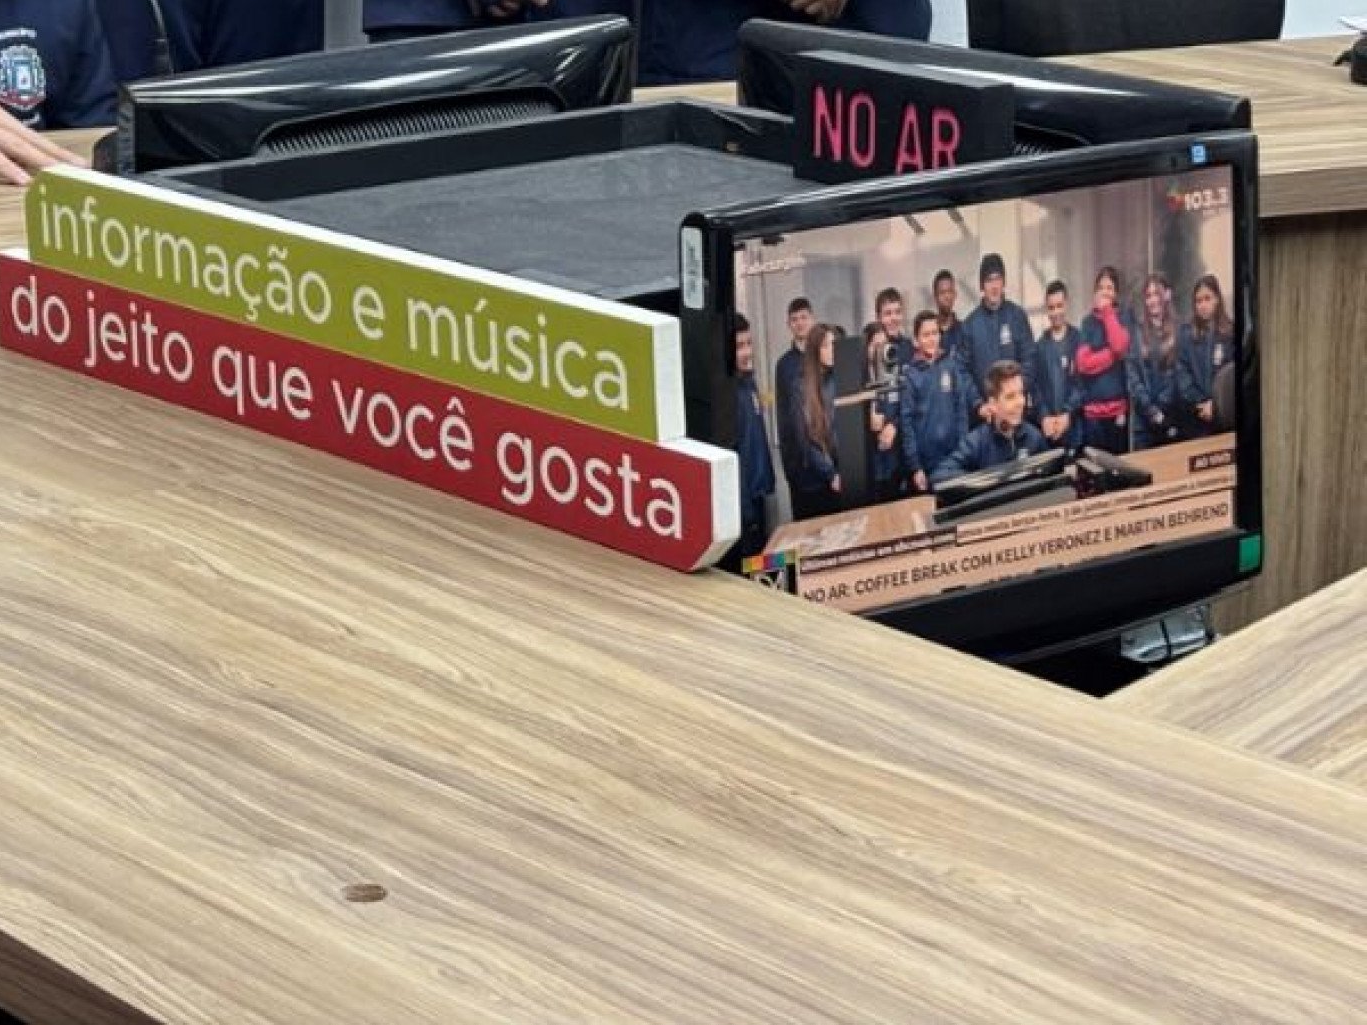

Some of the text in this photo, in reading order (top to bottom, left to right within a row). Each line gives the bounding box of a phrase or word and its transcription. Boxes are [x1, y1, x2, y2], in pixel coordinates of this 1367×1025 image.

[811, 85, 962, 176] NO AR
[37, 184, 630, 411] informação e música
[10, 275, 683, 540] do jeito que você gosta
[854, 571, 909, 596] COFFEE
[911, 559, 958, 583] BREAK
[961, 551, 992, 573] COM
[995, 542, 1036, 566] KELLY
[1115, 514, 1165, 541] MARTIN
